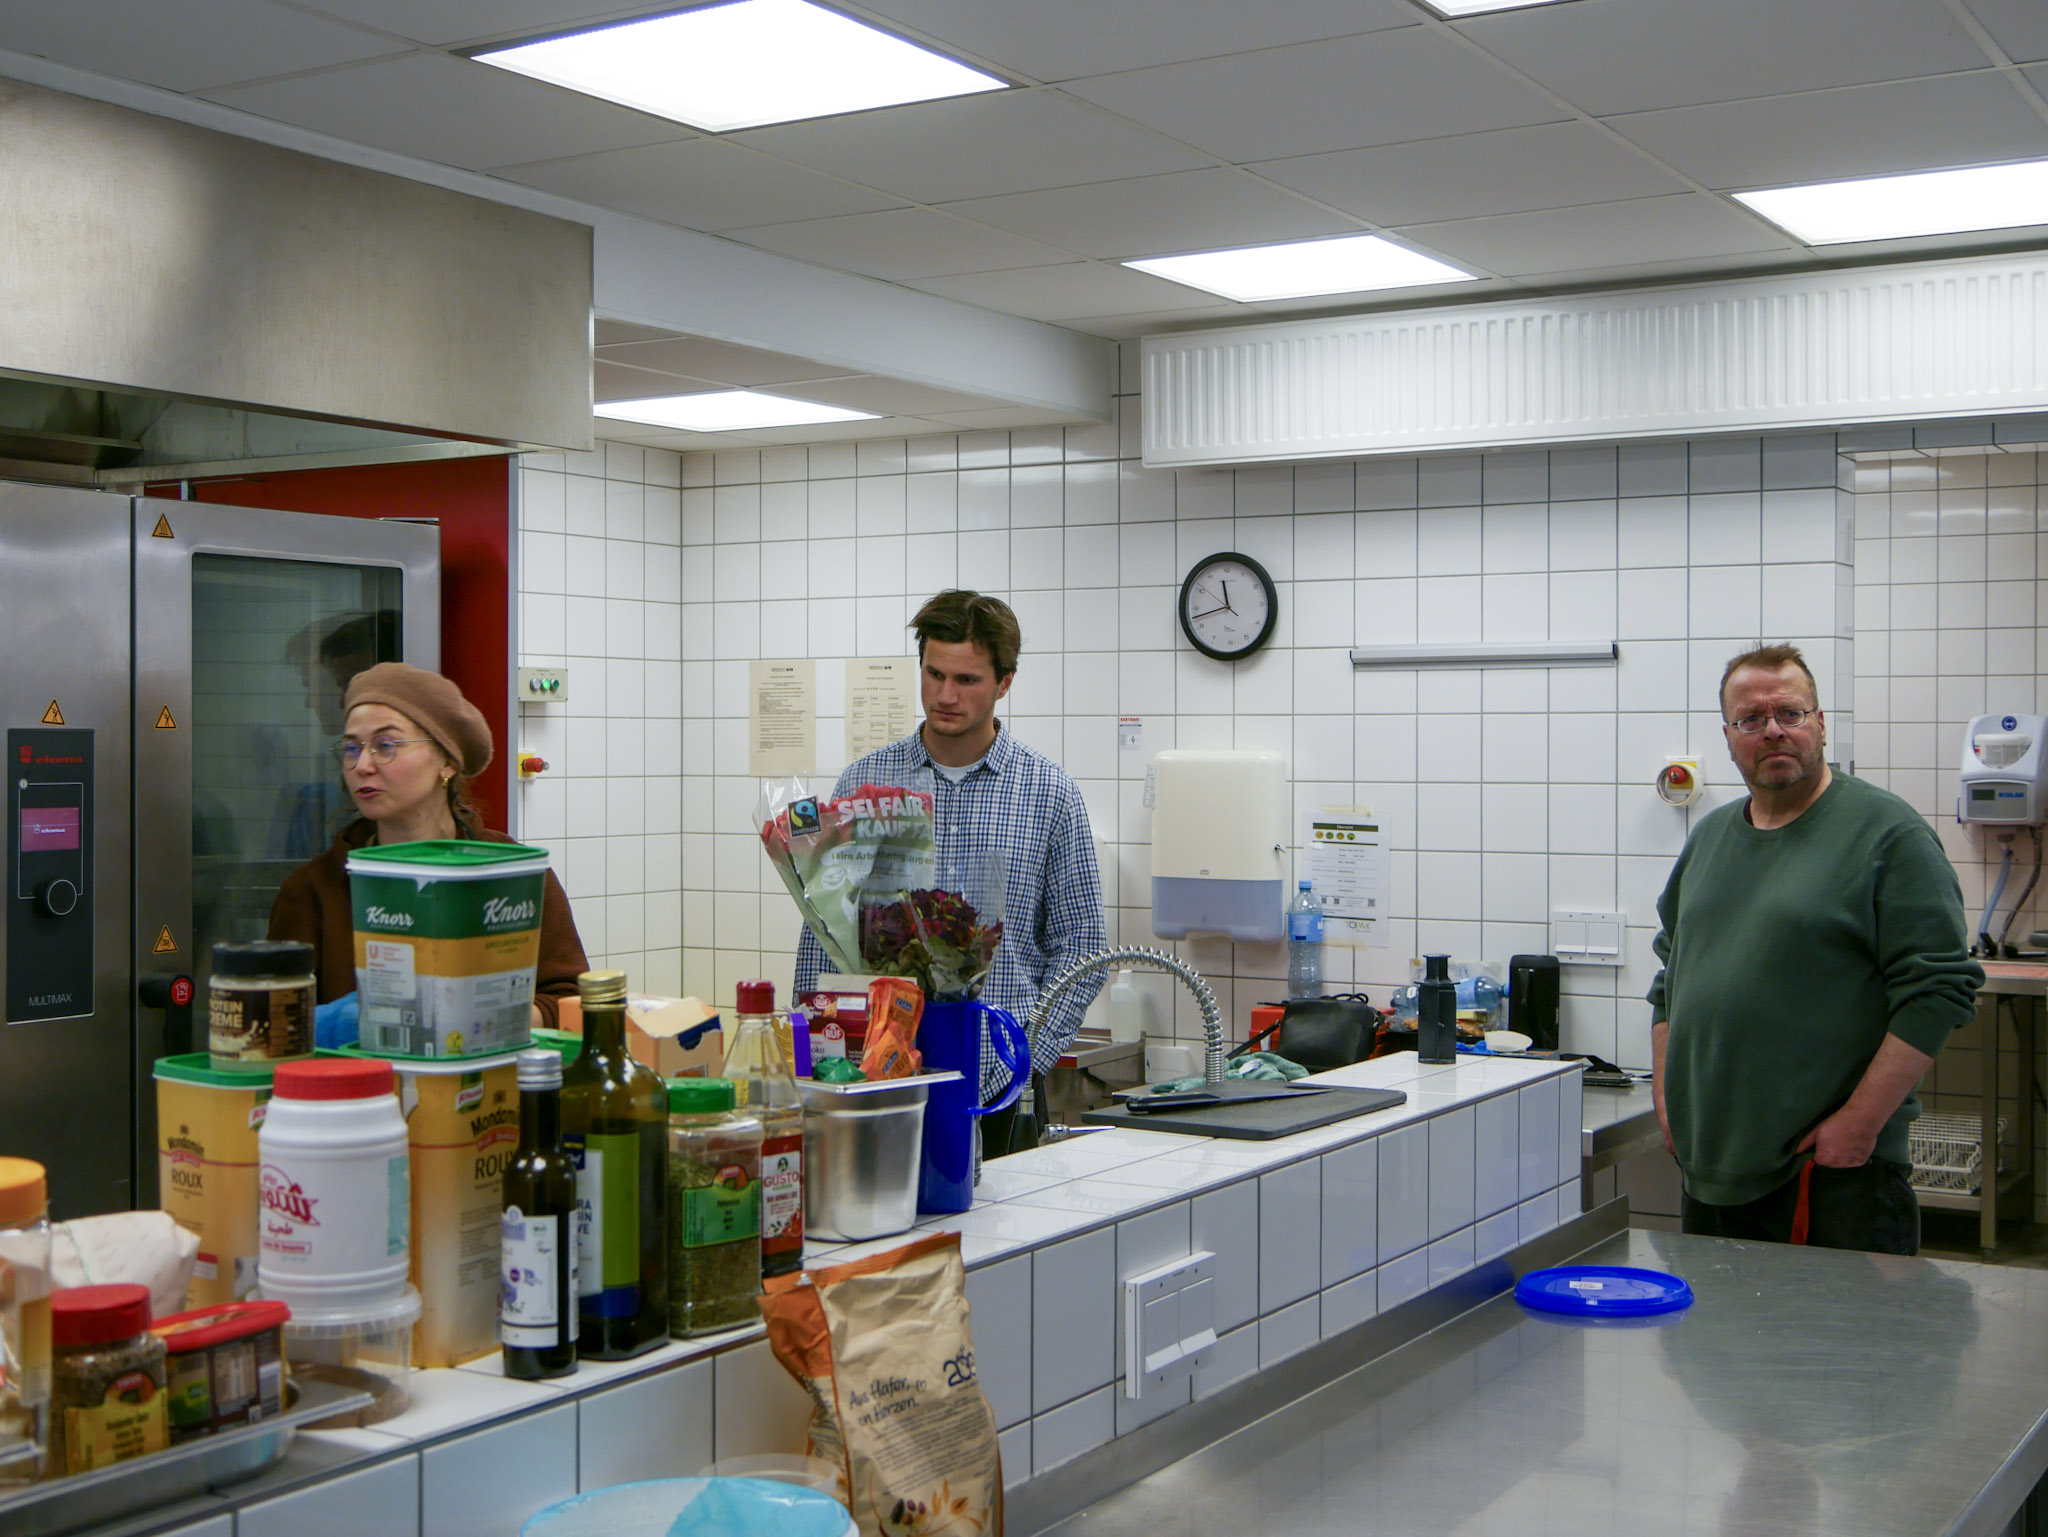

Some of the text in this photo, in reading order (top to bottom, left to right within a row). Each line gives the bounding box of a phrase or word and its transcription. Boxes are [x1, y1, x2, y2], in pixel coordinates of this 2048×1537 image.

[837, 796, 925, 825] SEI FAIR
[856, 820, 934, 841] KAUF FA
[366, 905, 414, 927] Knorr
[483, 896, 536, 925] Knorr
[28, 993, 73, 1007] MULTIMAX
[208, 998, 243, 1014] OTEIN
[825, 1029, 841, 1039] RUF
[811, 1045, 825, 1053] oko
[471, 1108, 520, 1138] Mondam
[172, 1168, 203, 1189] ROUX
[763, 1171, 801, 1189] GUSTO
[849, 1375, 911, 1411] Aus Hafer,
